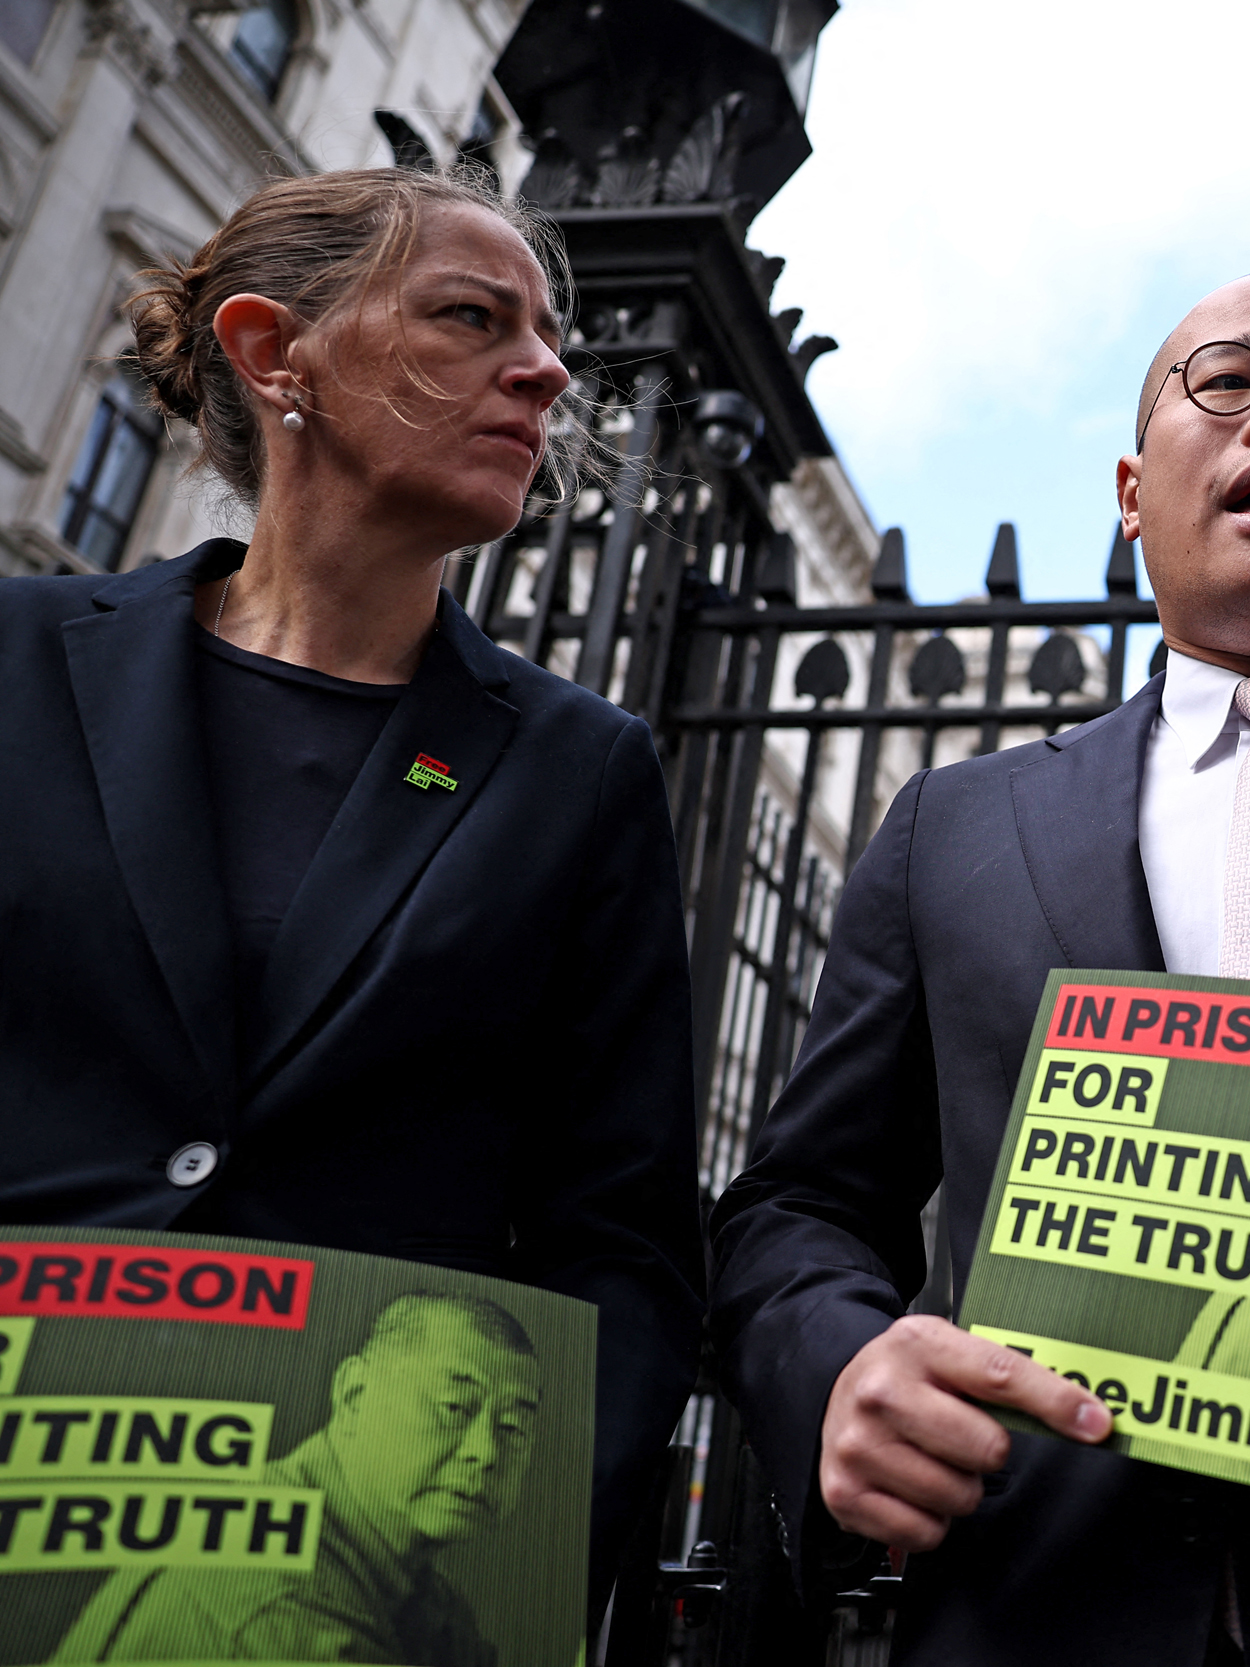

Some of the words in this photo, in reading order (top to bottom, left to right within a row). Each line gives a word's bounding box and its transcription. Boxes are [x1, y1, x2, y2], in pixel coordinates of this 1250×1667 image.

[408, 773, 428, 787] Lai
[413, 765, 455, 788] Jimmy
[418, 755, 446, 773] Free
[1057, 995, 1116, 1040] IN
[1039, 1060, 1153, 1114] FOR
[1009, 1196, 1117, 1258] THE
